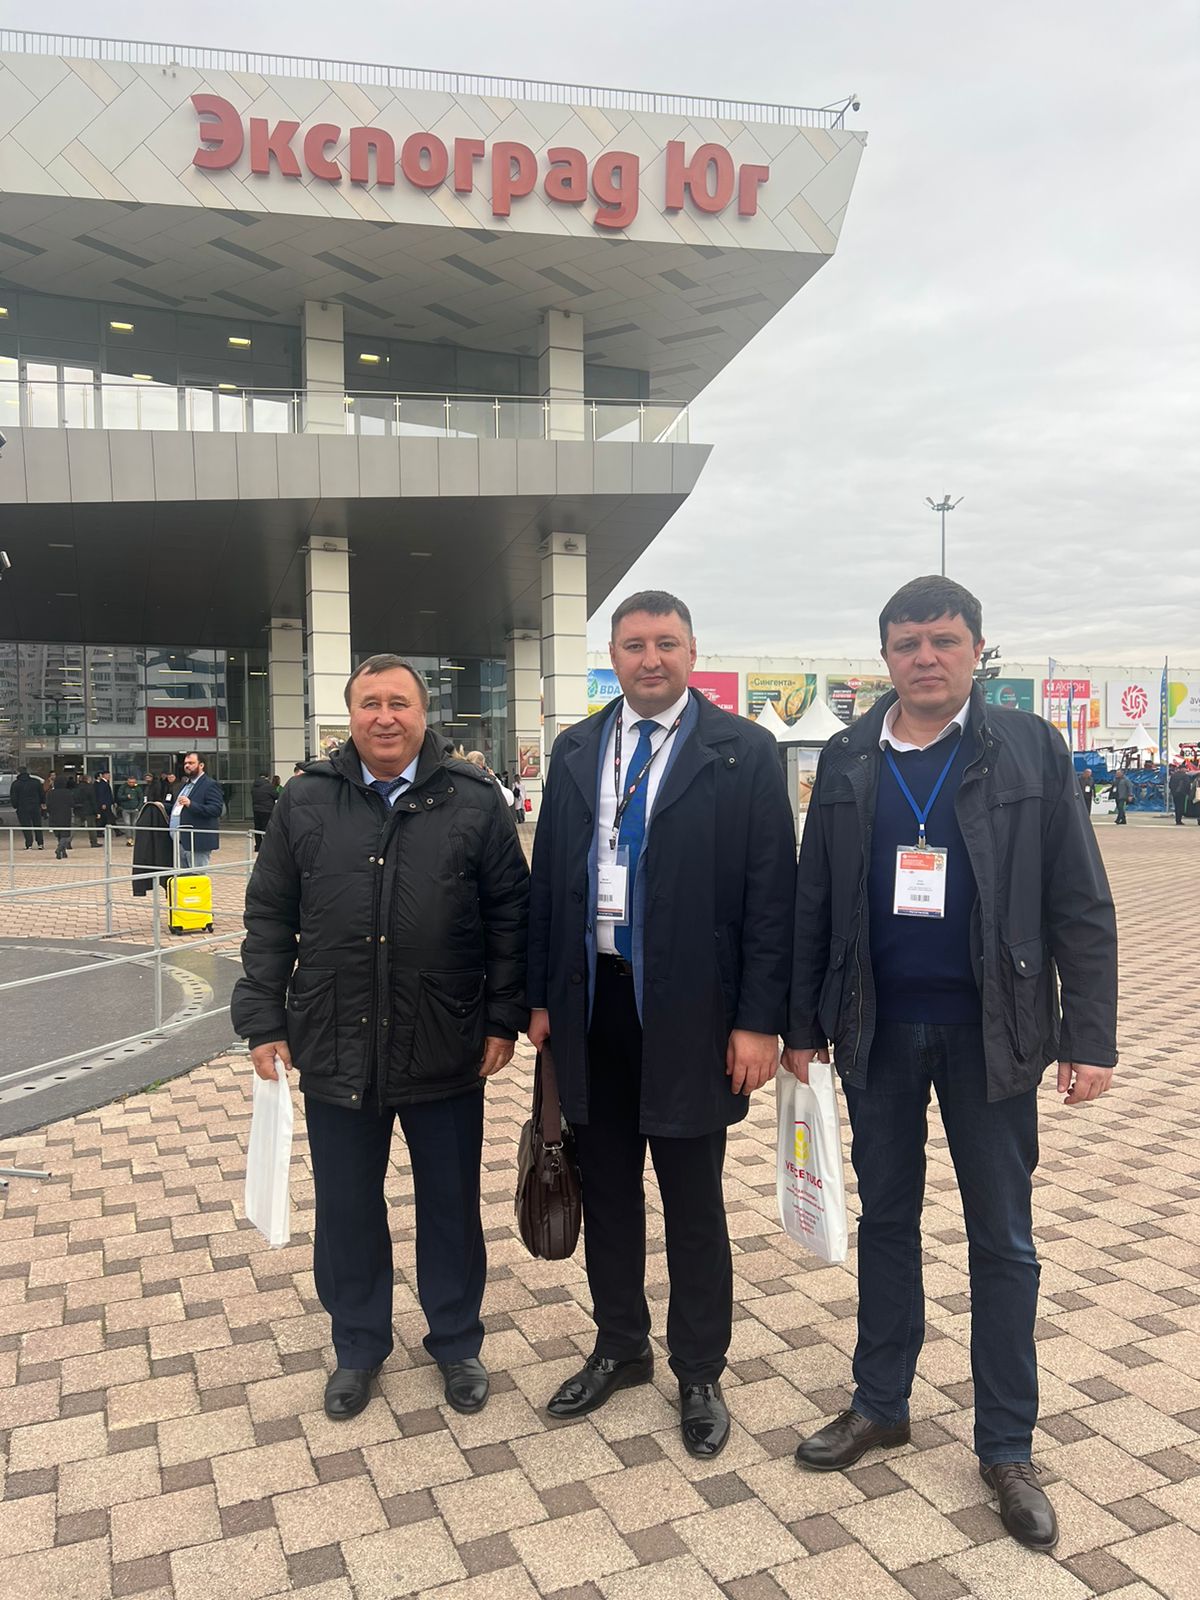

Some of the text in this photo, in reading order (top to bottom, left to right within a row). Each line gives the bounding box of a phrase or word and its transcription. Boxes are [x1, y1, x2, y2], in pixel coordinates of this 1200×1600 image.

[191, 94, 770, 229] Экспоград Юг
[1130, 695, 1140, 710] LG
[155, 715, 208, 731] ВХОД
